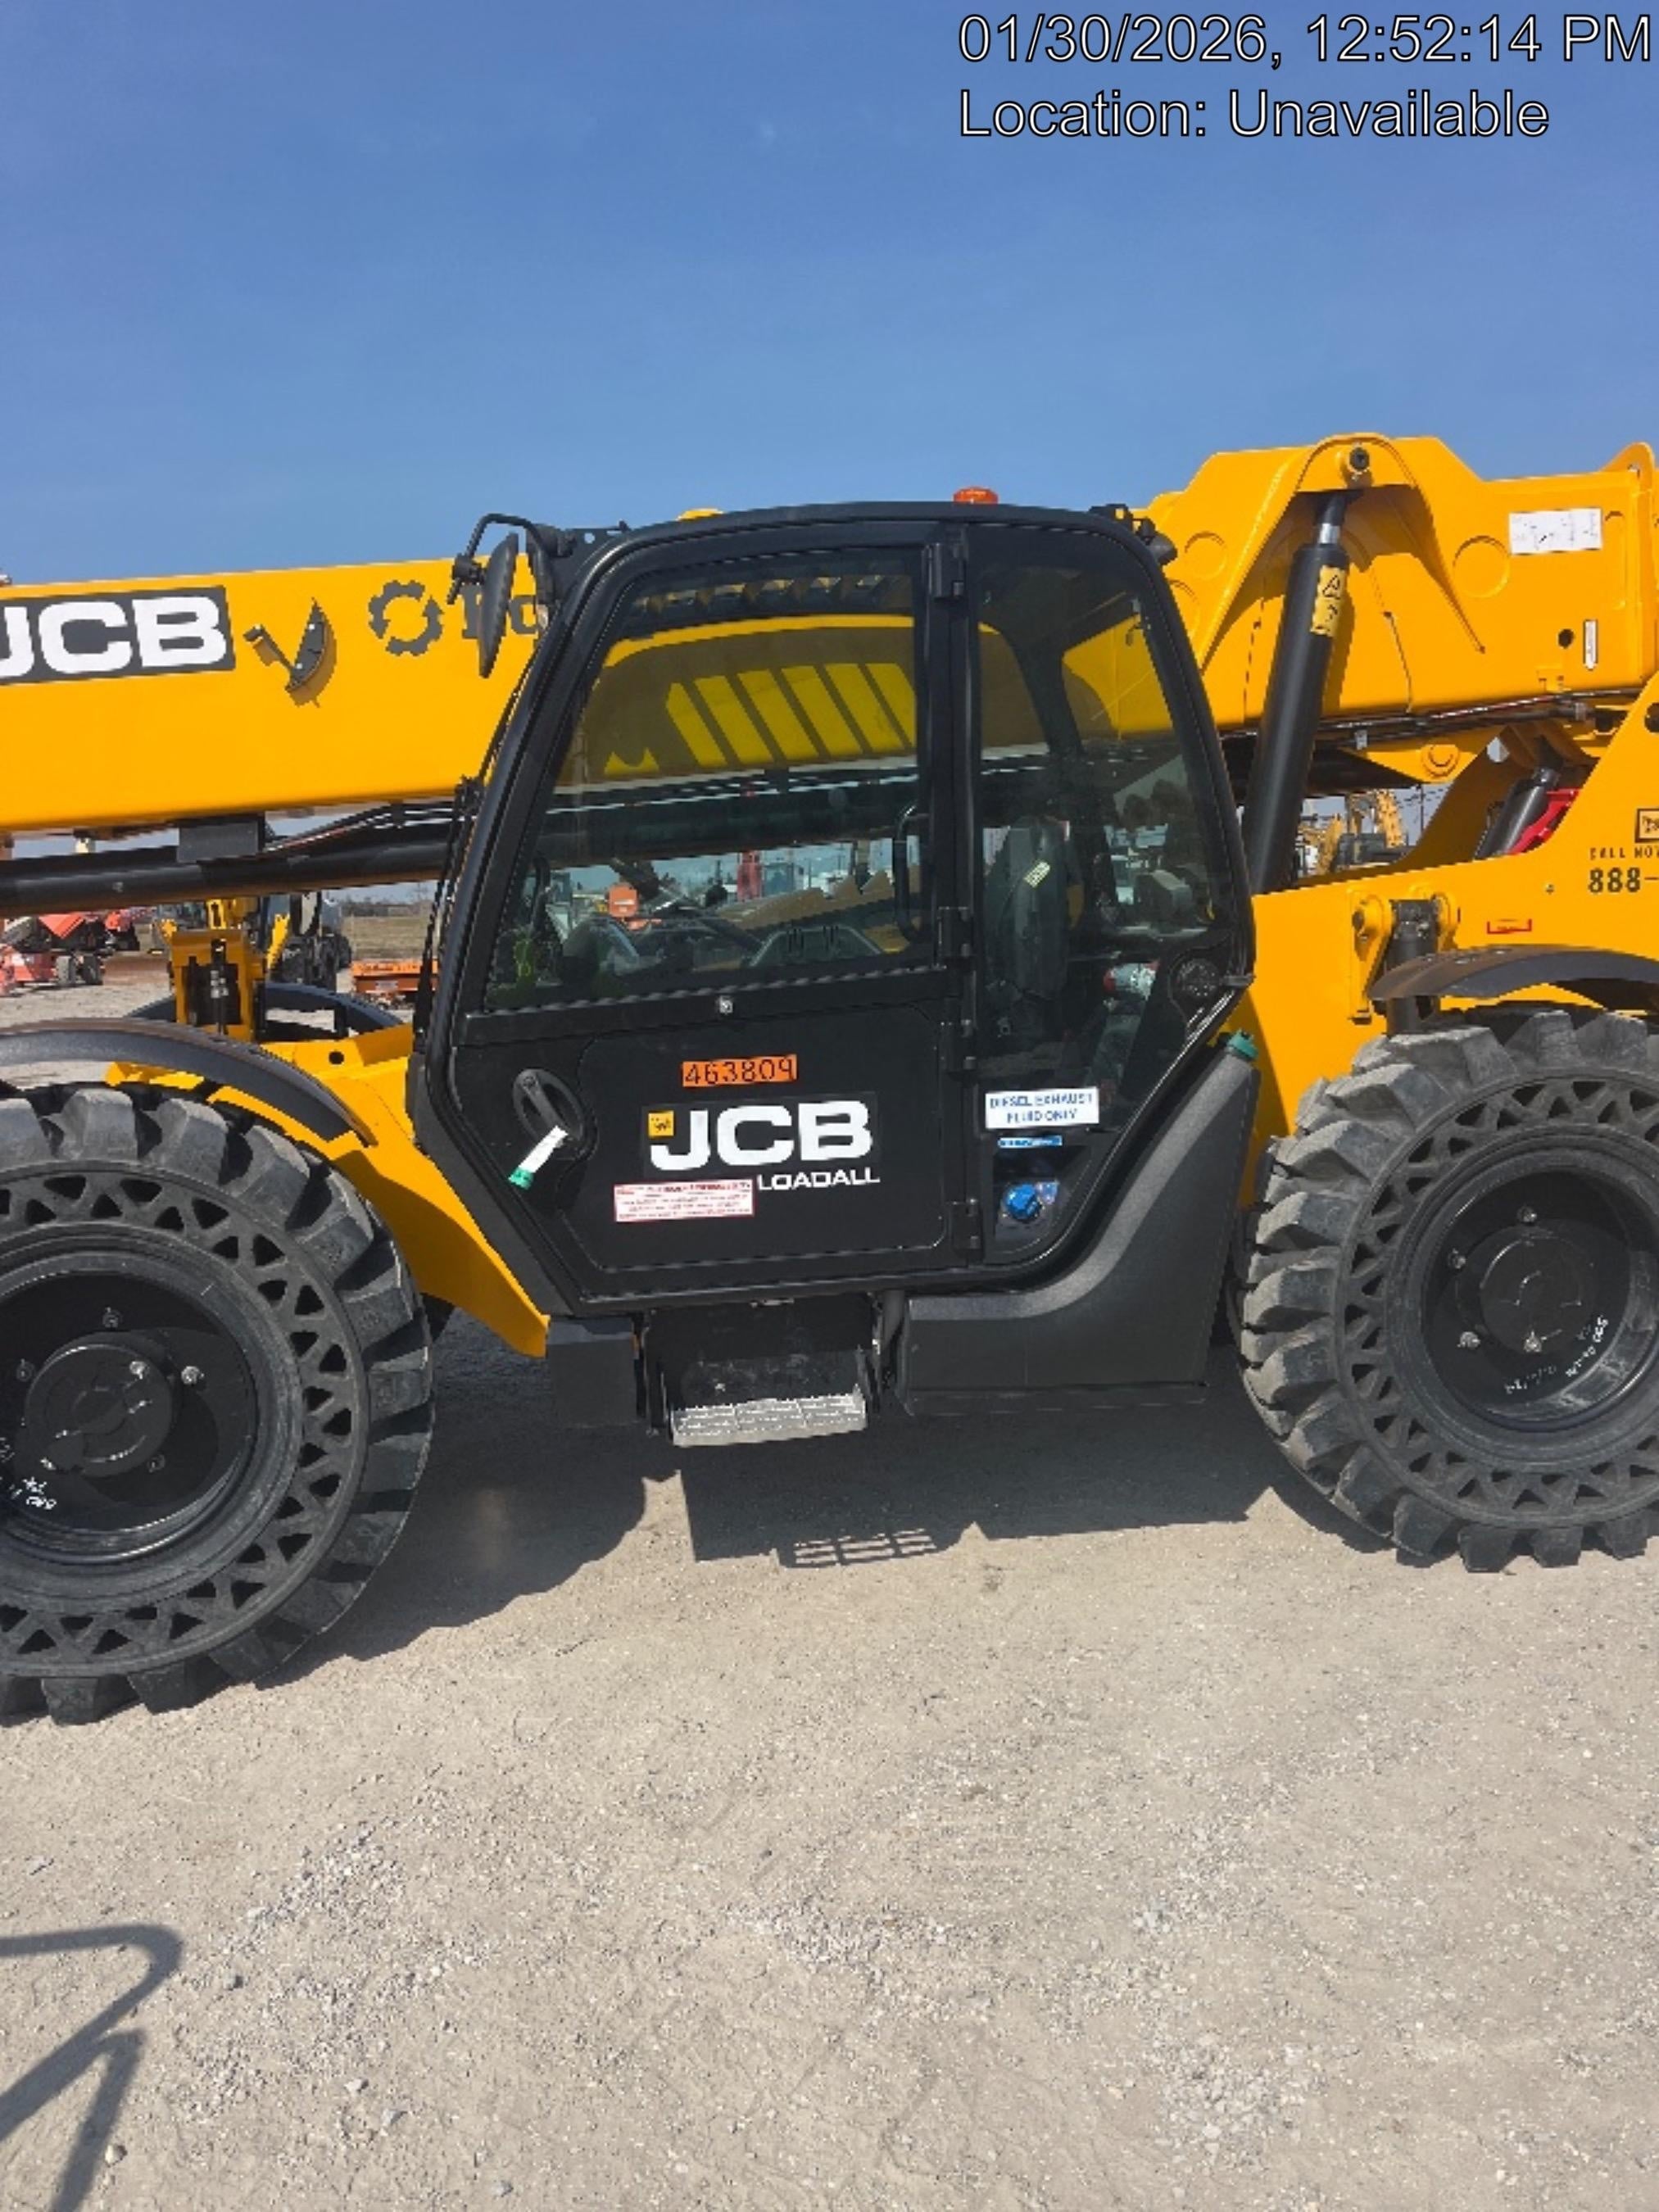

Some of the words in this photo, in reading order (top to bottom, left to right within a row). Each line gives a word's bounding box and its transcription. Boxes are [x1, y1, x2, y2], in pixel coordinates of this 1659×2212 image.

[683, 1056, 796, 1086] 463809
[990, 1095, 1033, 1109] DIESEL
[650, 1100, 873, 1171] JCB
[757, 1167, 881, 1191] LOADALL
